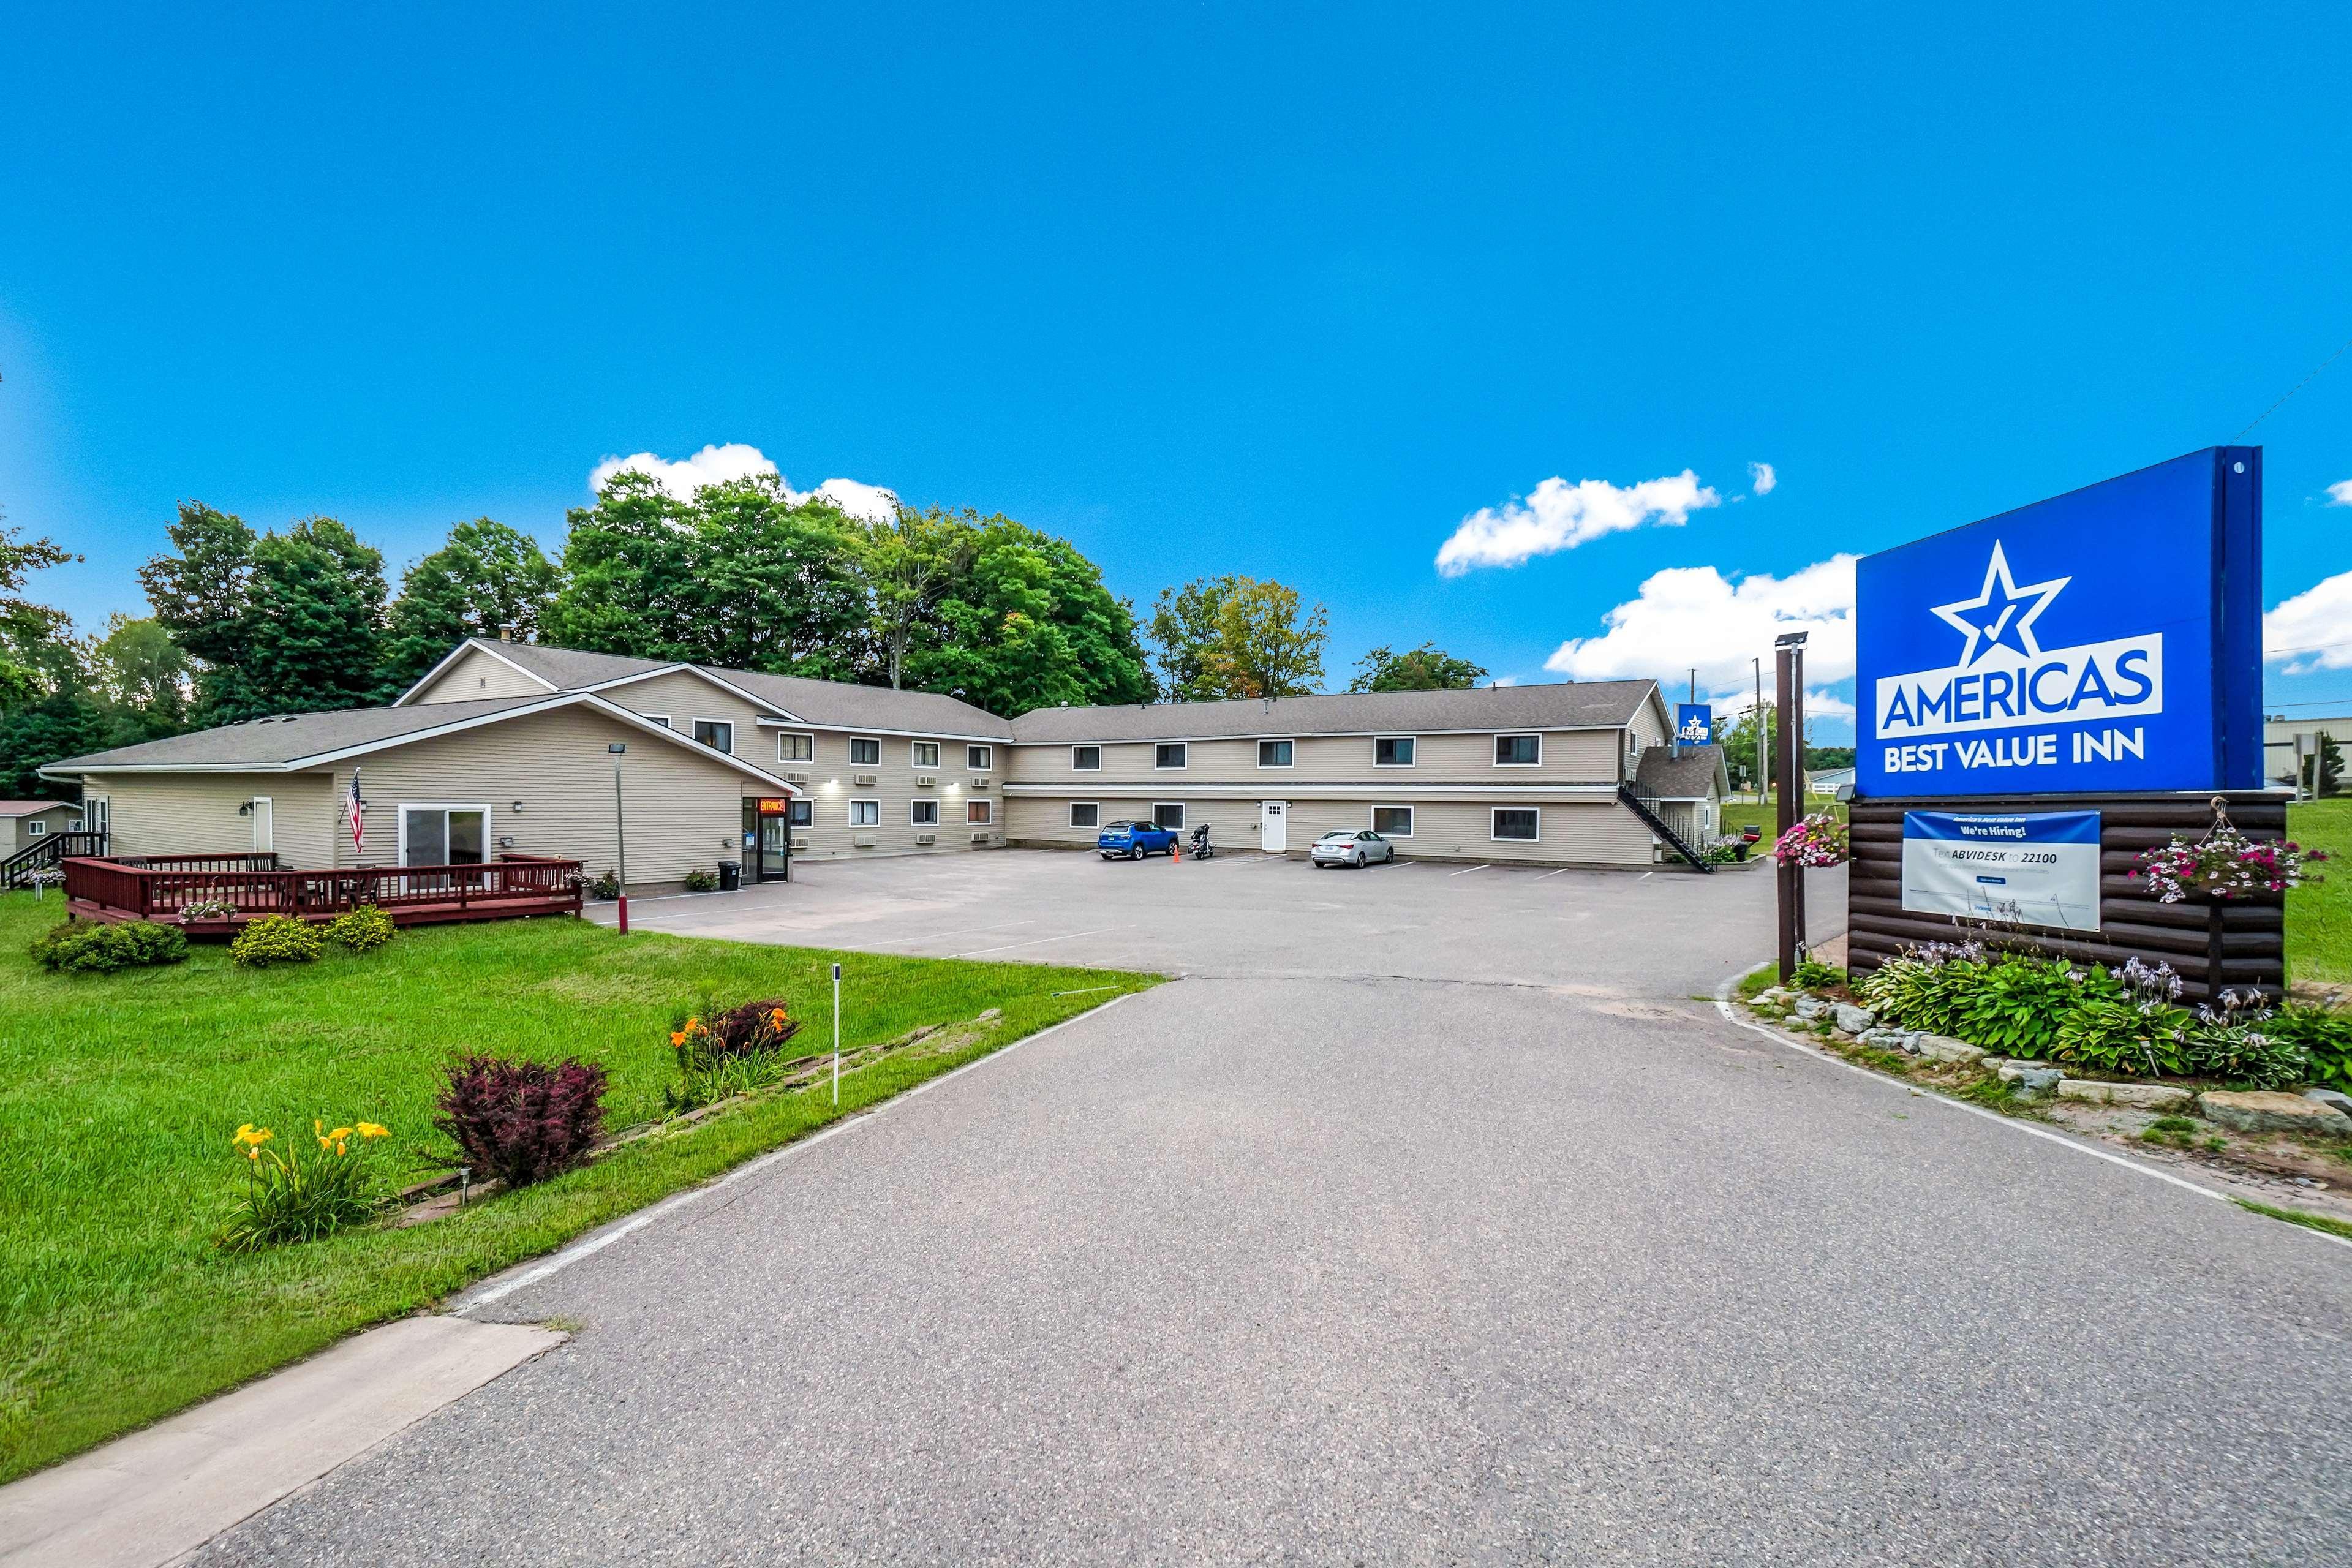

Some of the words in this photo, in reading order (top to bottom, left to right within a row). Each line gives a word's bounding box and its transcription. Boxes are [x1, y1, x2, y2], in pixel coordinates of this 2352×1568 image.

[1882, 650, 2152, 730] AMERICAS
[1885, 743, 1948, 772] BEST
[1954, 734, 2057, 769] VALUE
[2073, 727, 2144, 763] INN
[761, 801, 783, 811] ENTRANCE
[1960, 826, 1988, 835] We're
[1989, 826, 2027, 839] Hiring!
[1951, 850, 2007, 861] ABVIDESK
[2009, 853, 2019, 862] to
[2021, 853, 2057, 864] 22100
